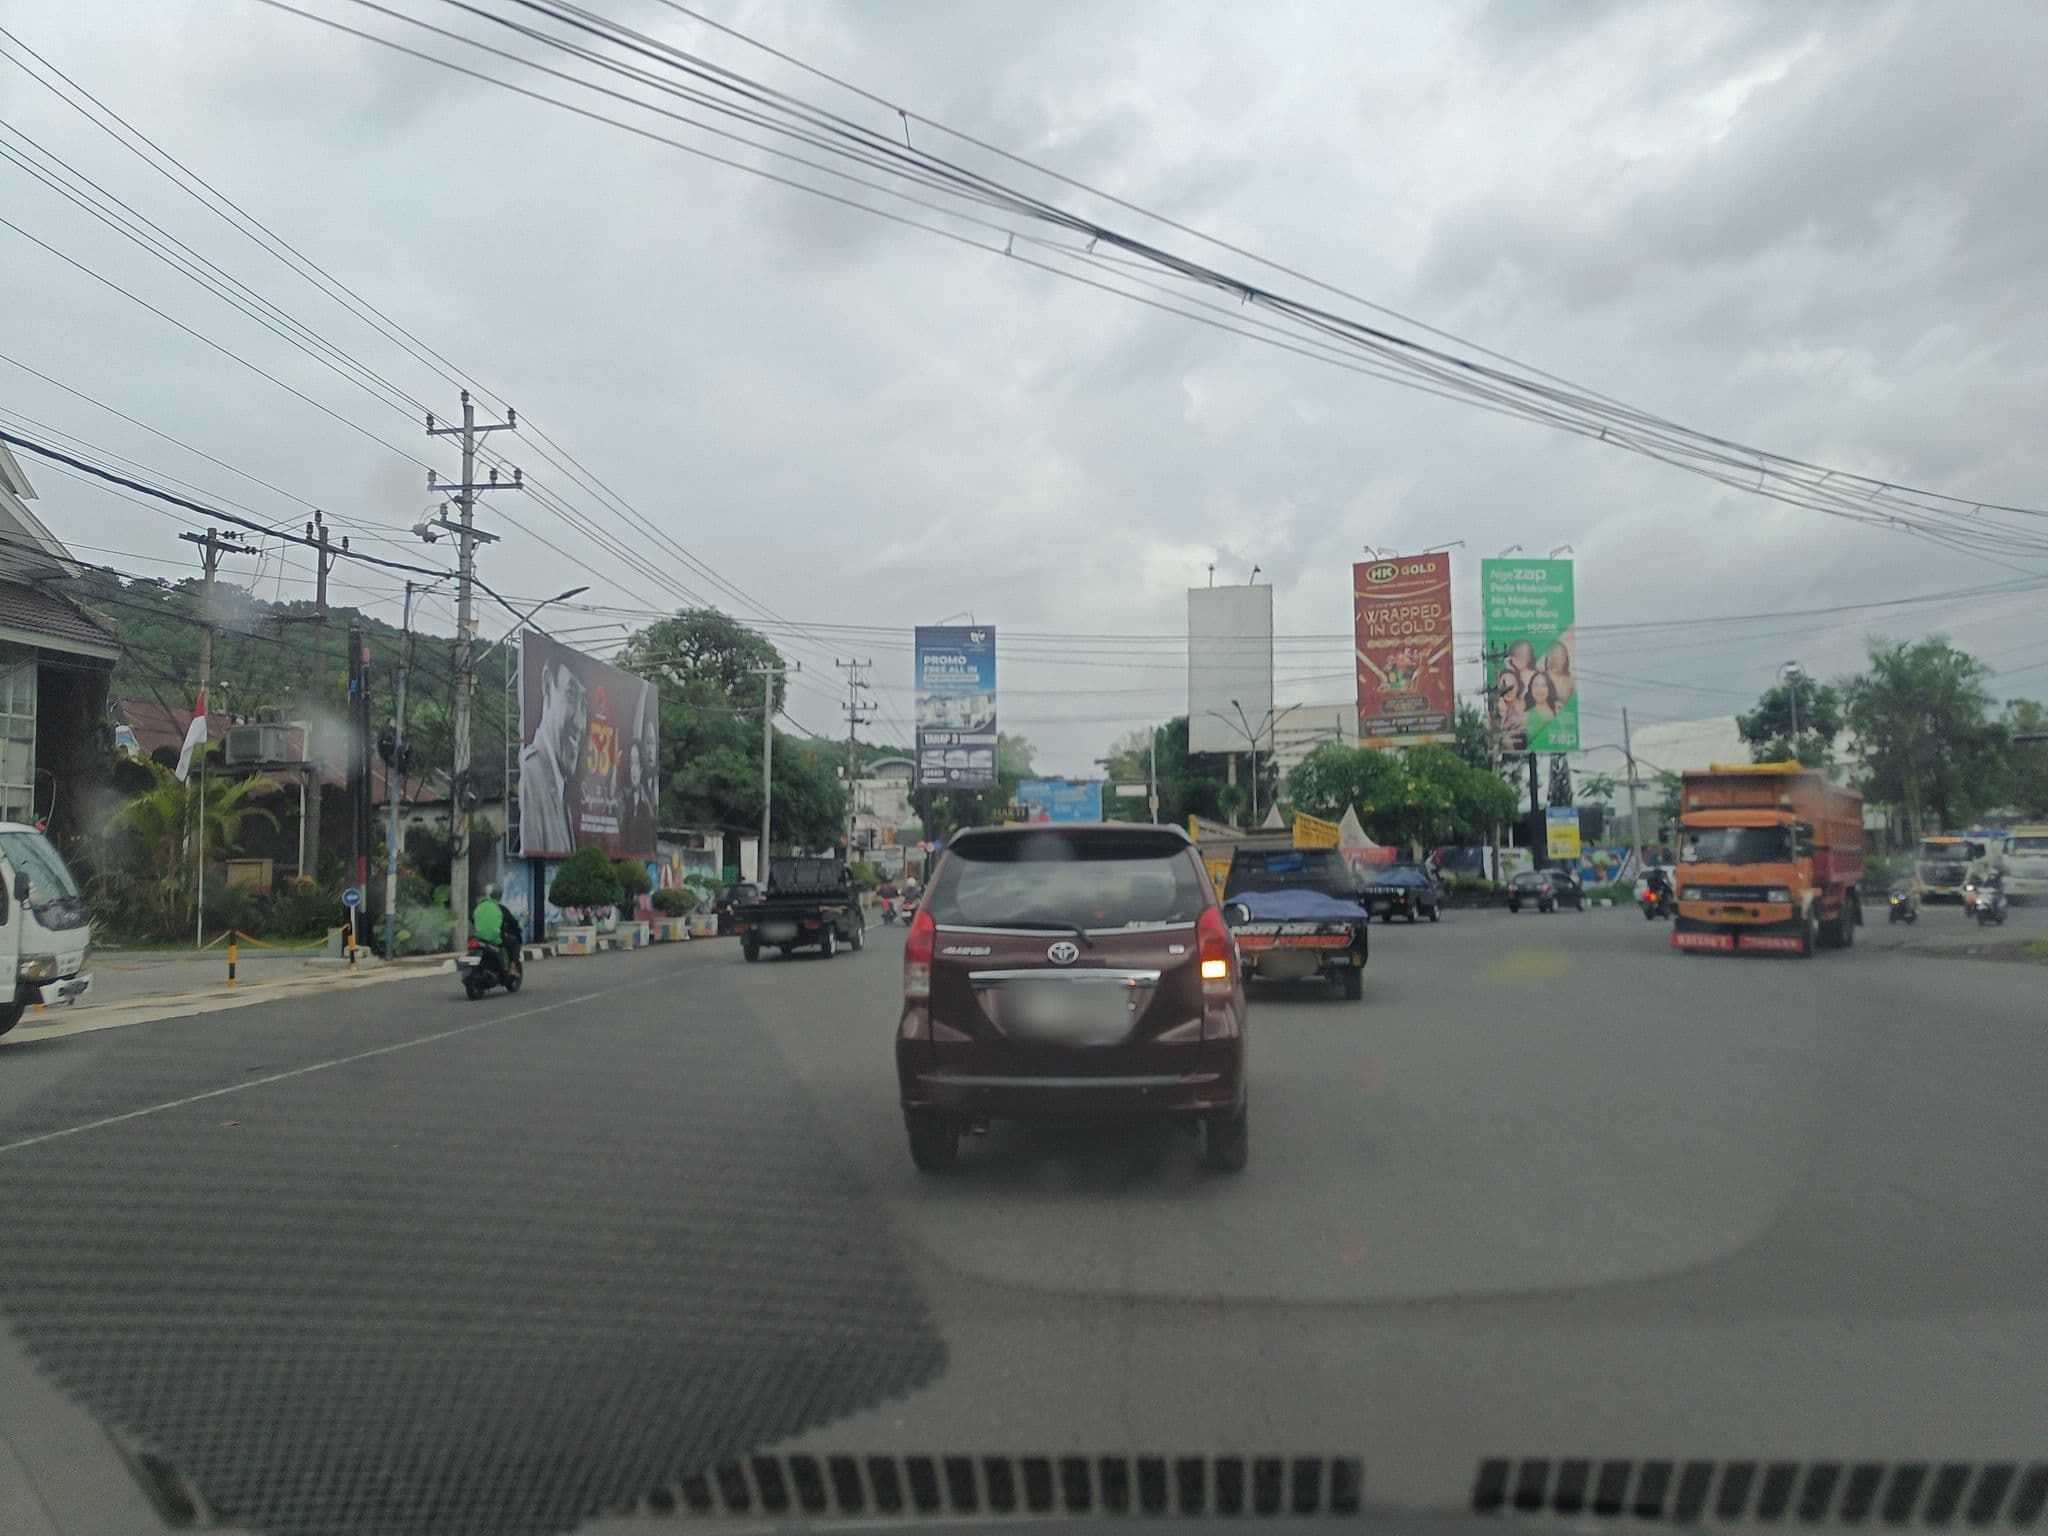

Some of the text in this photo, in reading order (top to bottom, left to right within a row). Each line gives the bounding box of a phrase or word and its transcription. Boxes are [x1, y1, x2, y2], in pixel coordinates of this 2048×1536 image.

[1369, 562, 1437, 581] HK GOLD
[1362, 603, 1442, 625] WRAPPED
[1369, 618, 1437, 637] IN GOLD
[923, 655, 967, 665] PROMO
